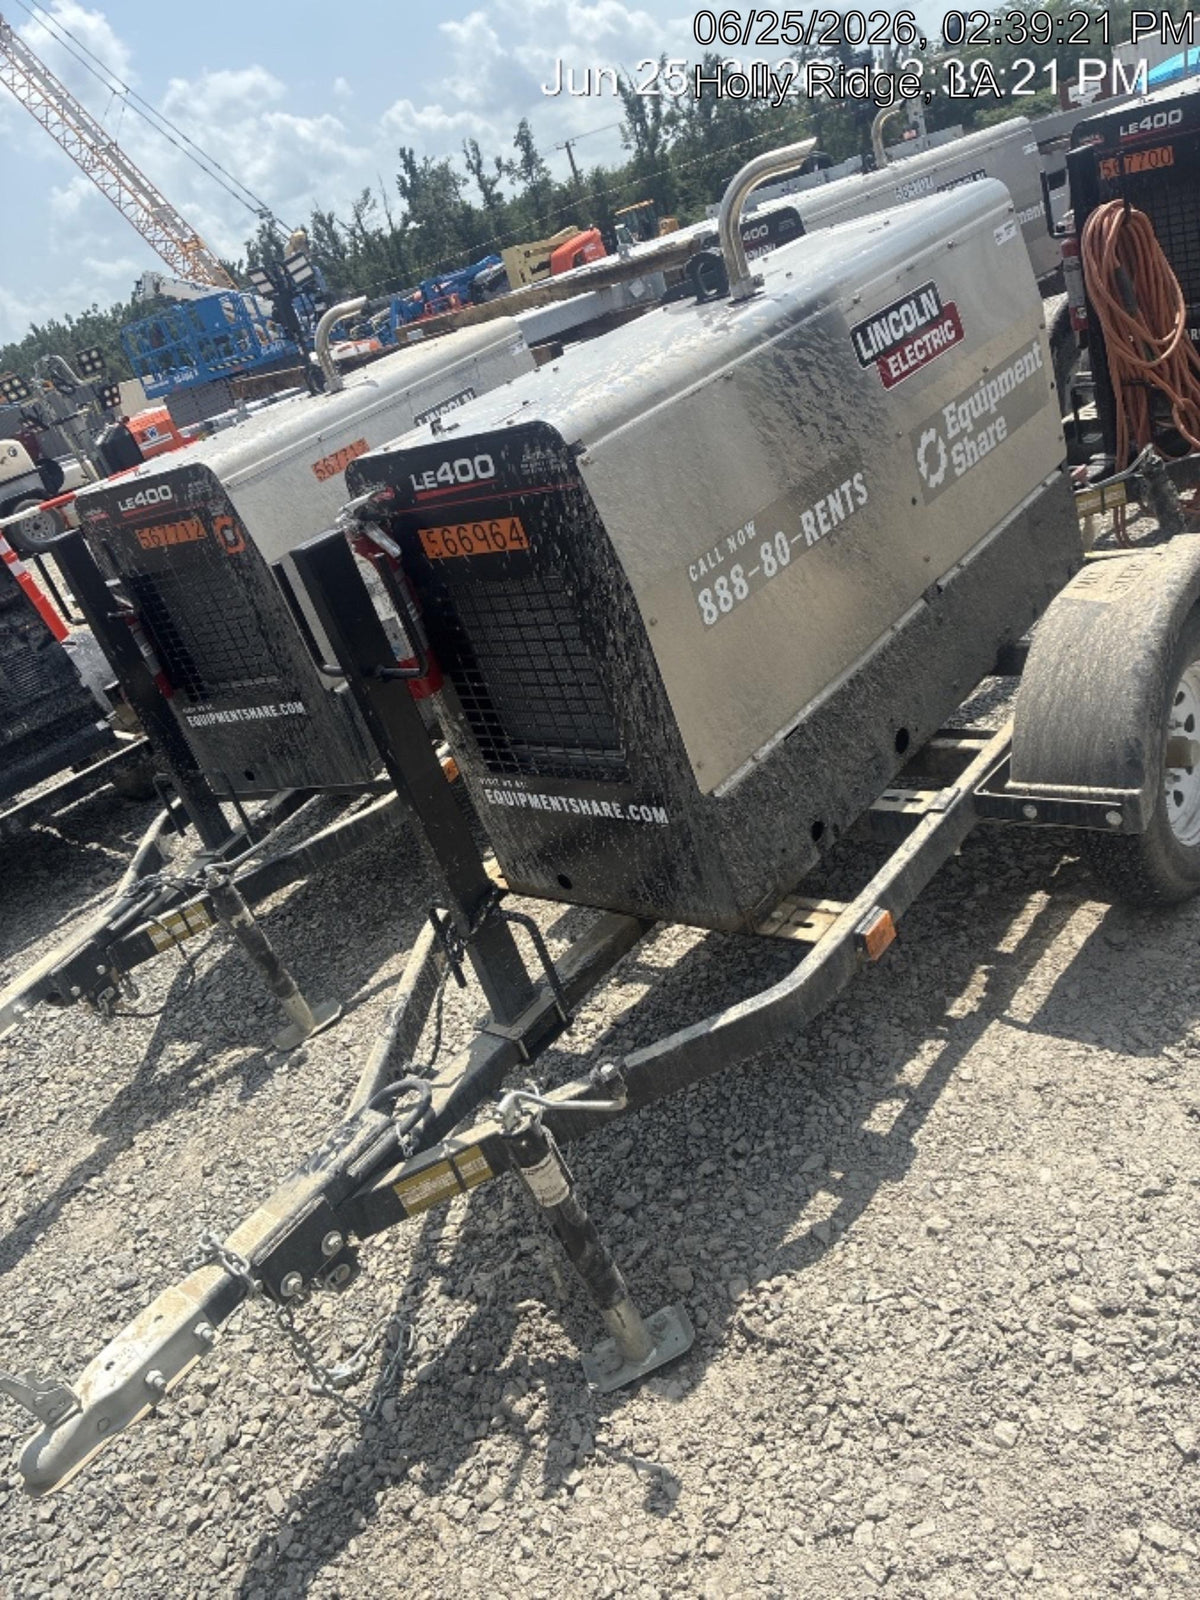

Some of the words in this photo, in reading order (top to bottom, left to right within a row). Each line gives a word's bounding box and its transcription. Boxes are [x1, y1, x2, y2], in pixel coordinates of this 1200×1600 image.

[1119, 108, 1184, 136] LE400
[856, 288, 940, 361] LINCOLN
[887, 319, 956, 379] ELECTRIC
[942, 340, 1043, 440] Equipment
[950, 415, 1008, 478] Share
[409, 453, 496, 491] LE400
[118, 484, 174, 512] LE400
[426, 517, 524, 557] 566964
[688, 546, 725, 582] CALL
[726, 520, 757, 554] NOW
[698, 472, 868, 625] 888-80-RENTS
[185, 701, 305, 728] EQUIPMENTSHARE.COM
[484, 788, 670, 825] EQUIPMENTSHARE.COM
